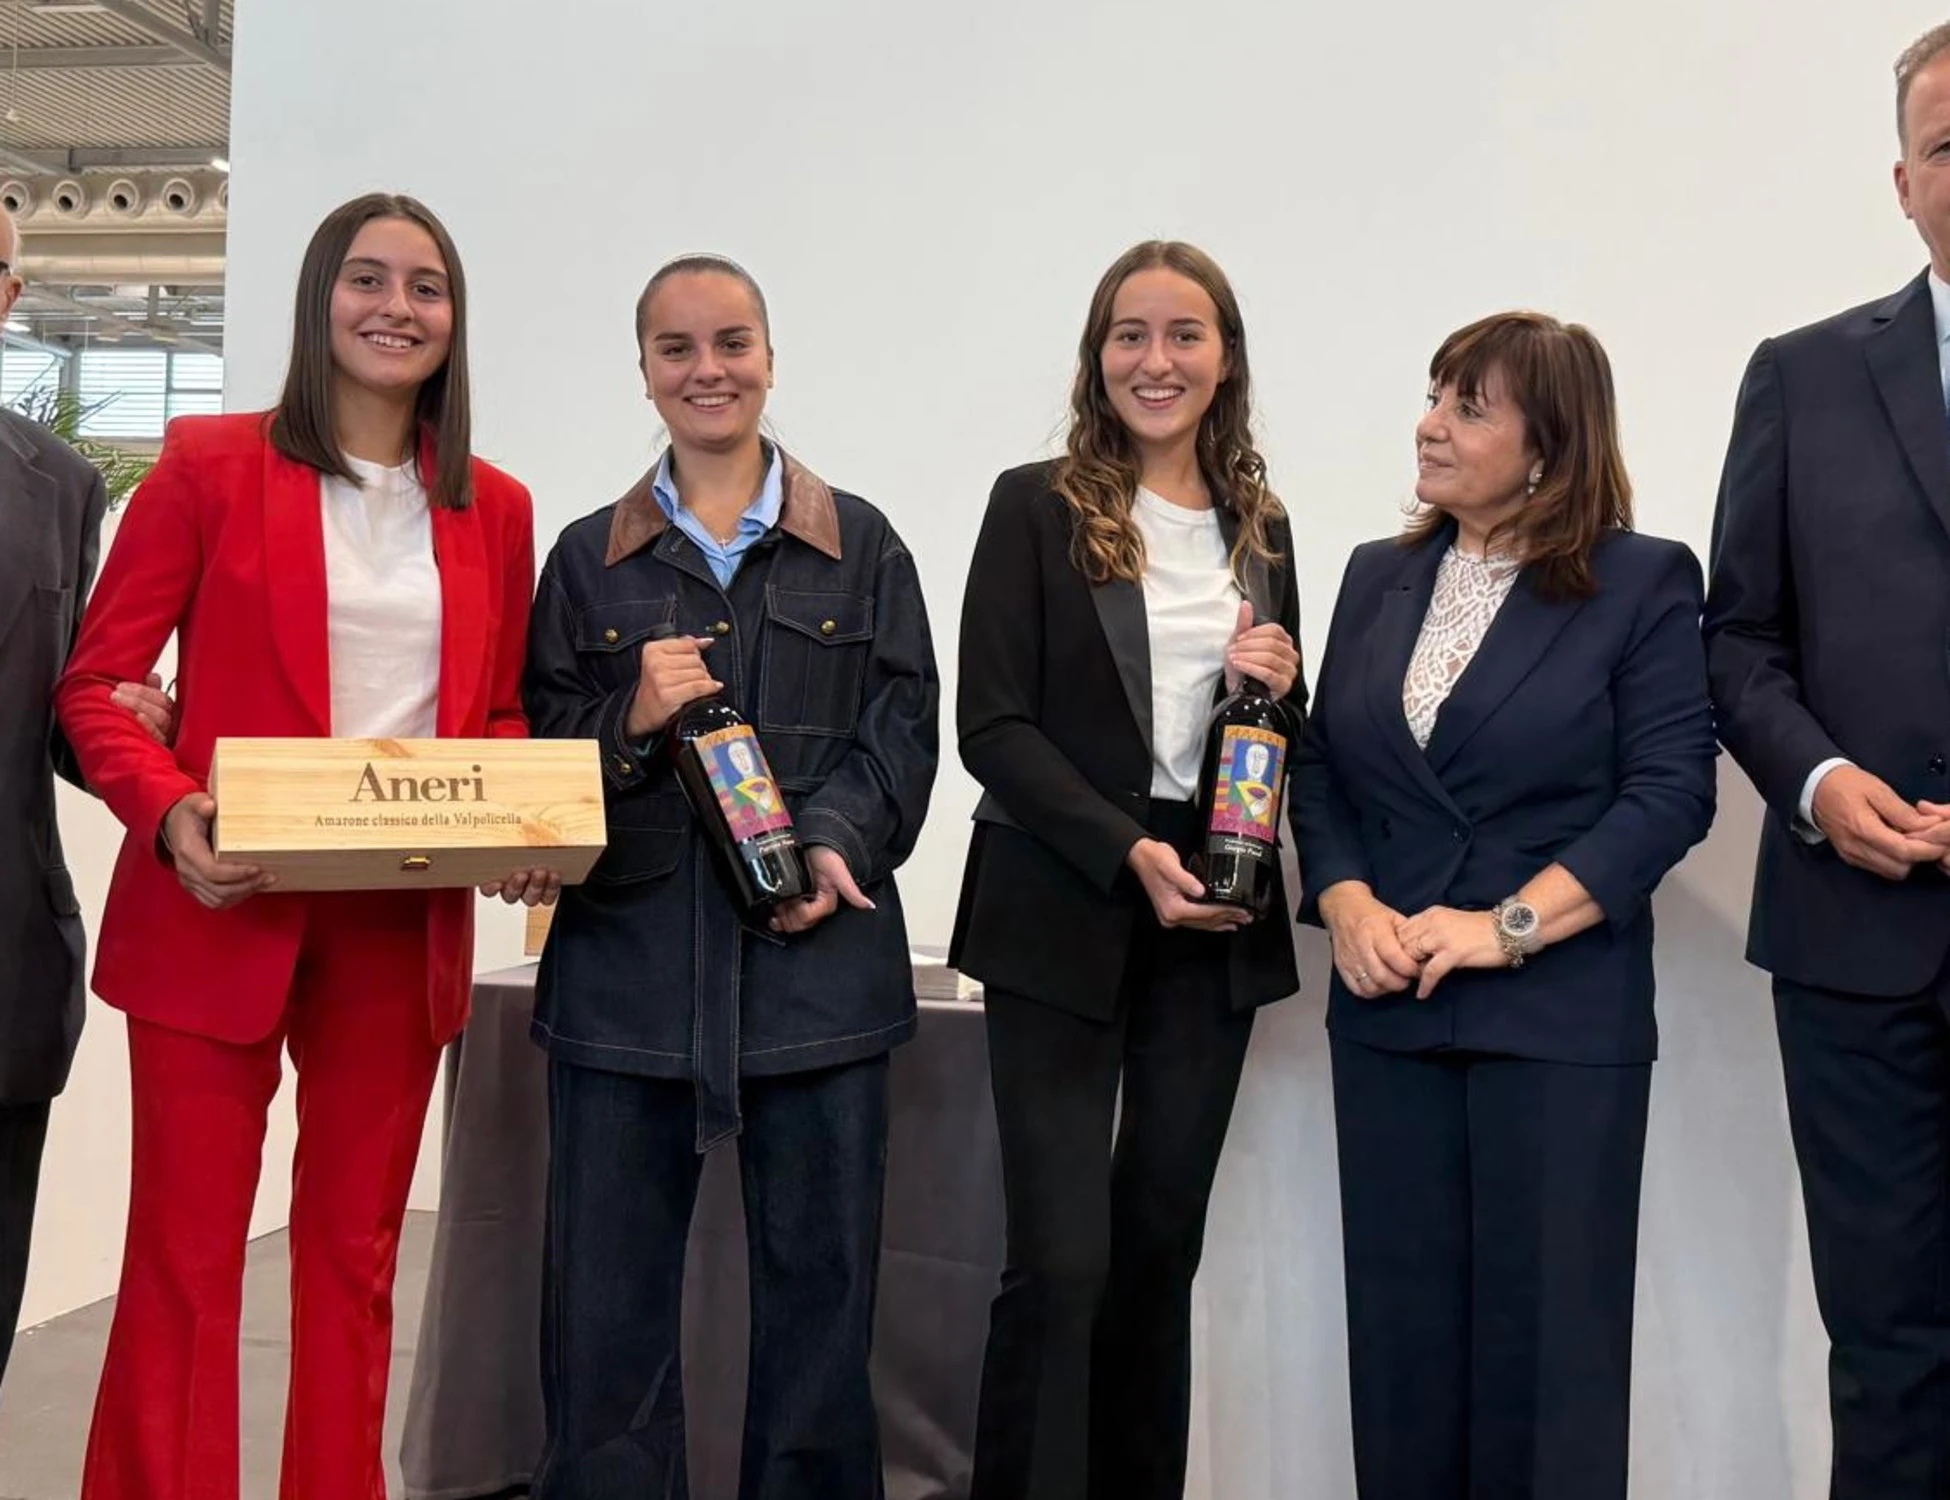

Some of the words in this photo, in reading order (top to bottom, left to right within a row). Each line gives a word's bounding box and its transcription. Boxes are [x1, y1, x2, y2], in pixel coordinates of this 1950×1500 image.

[348, 762, 488, 802] Aneri
[315, 815, 369, 827] Amarone
[372, 813, 418, 827] classico
[421, 812, 450, 826] della
[454, 812, 522, 828] Valpolicella
